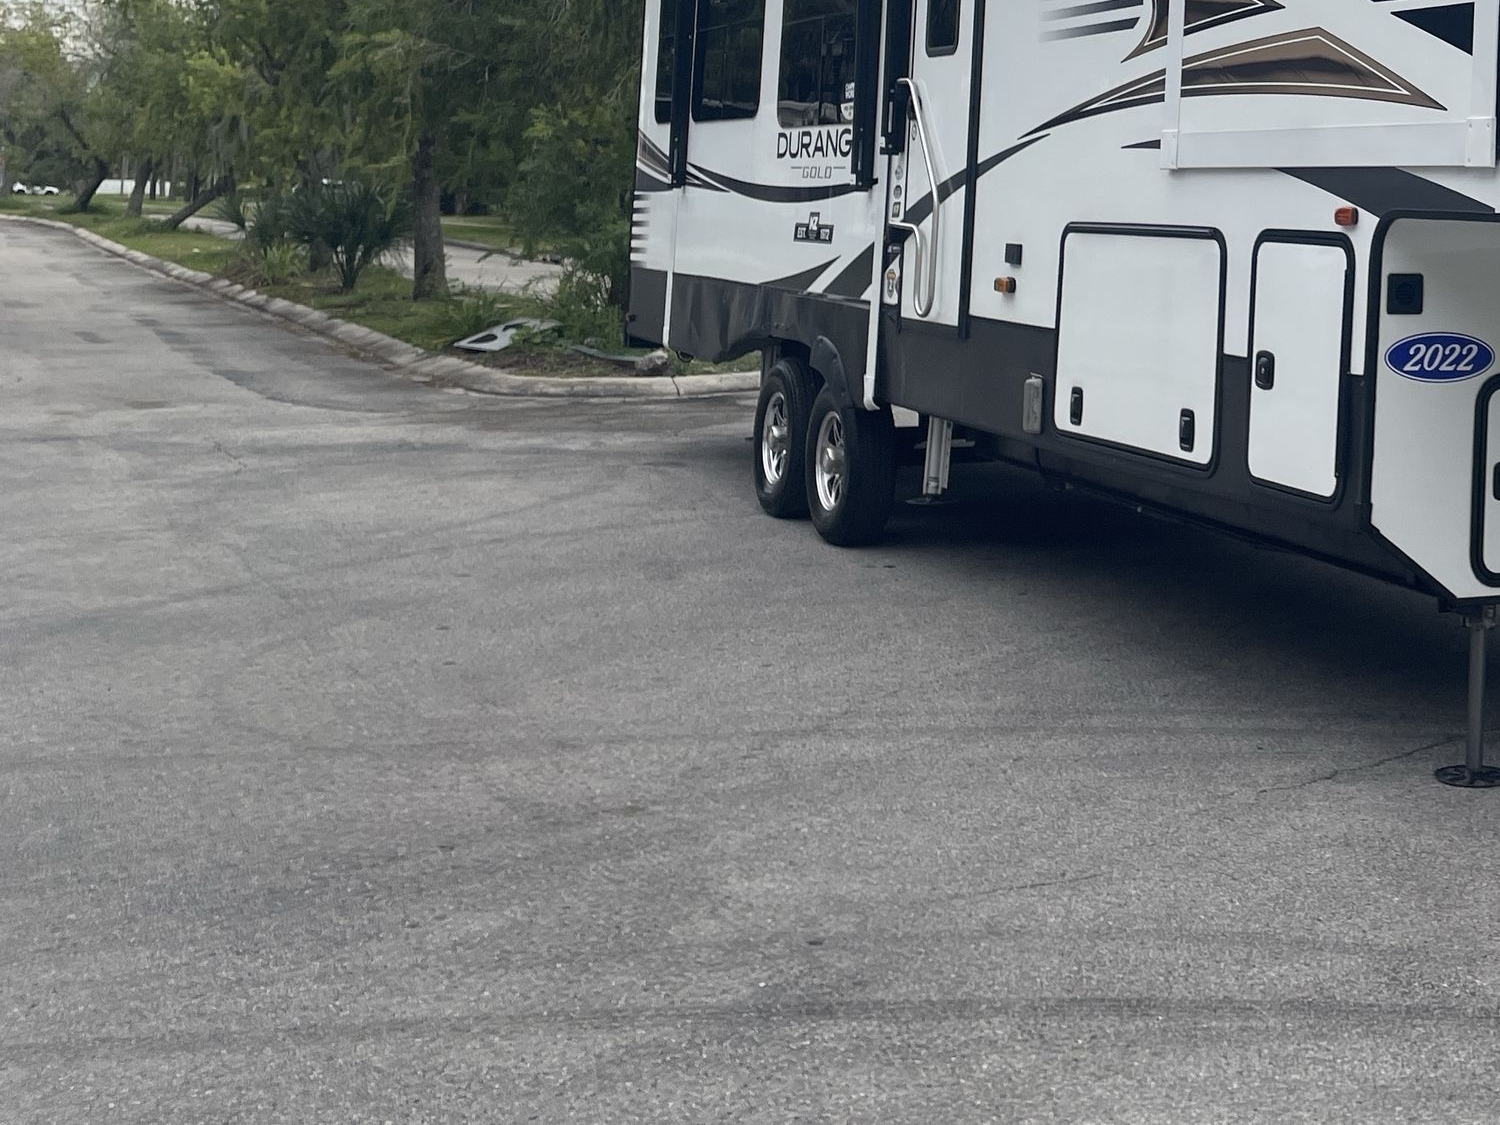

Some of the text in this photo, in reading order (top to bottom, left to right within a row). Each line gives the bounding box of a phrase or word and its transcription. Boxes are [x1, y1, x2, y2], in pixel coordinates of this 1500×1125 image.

[777, 128, 852, 159] DURANG
[802, 166, 833, 179] GOLD
[1402, 344, 1479, 372] 2022
